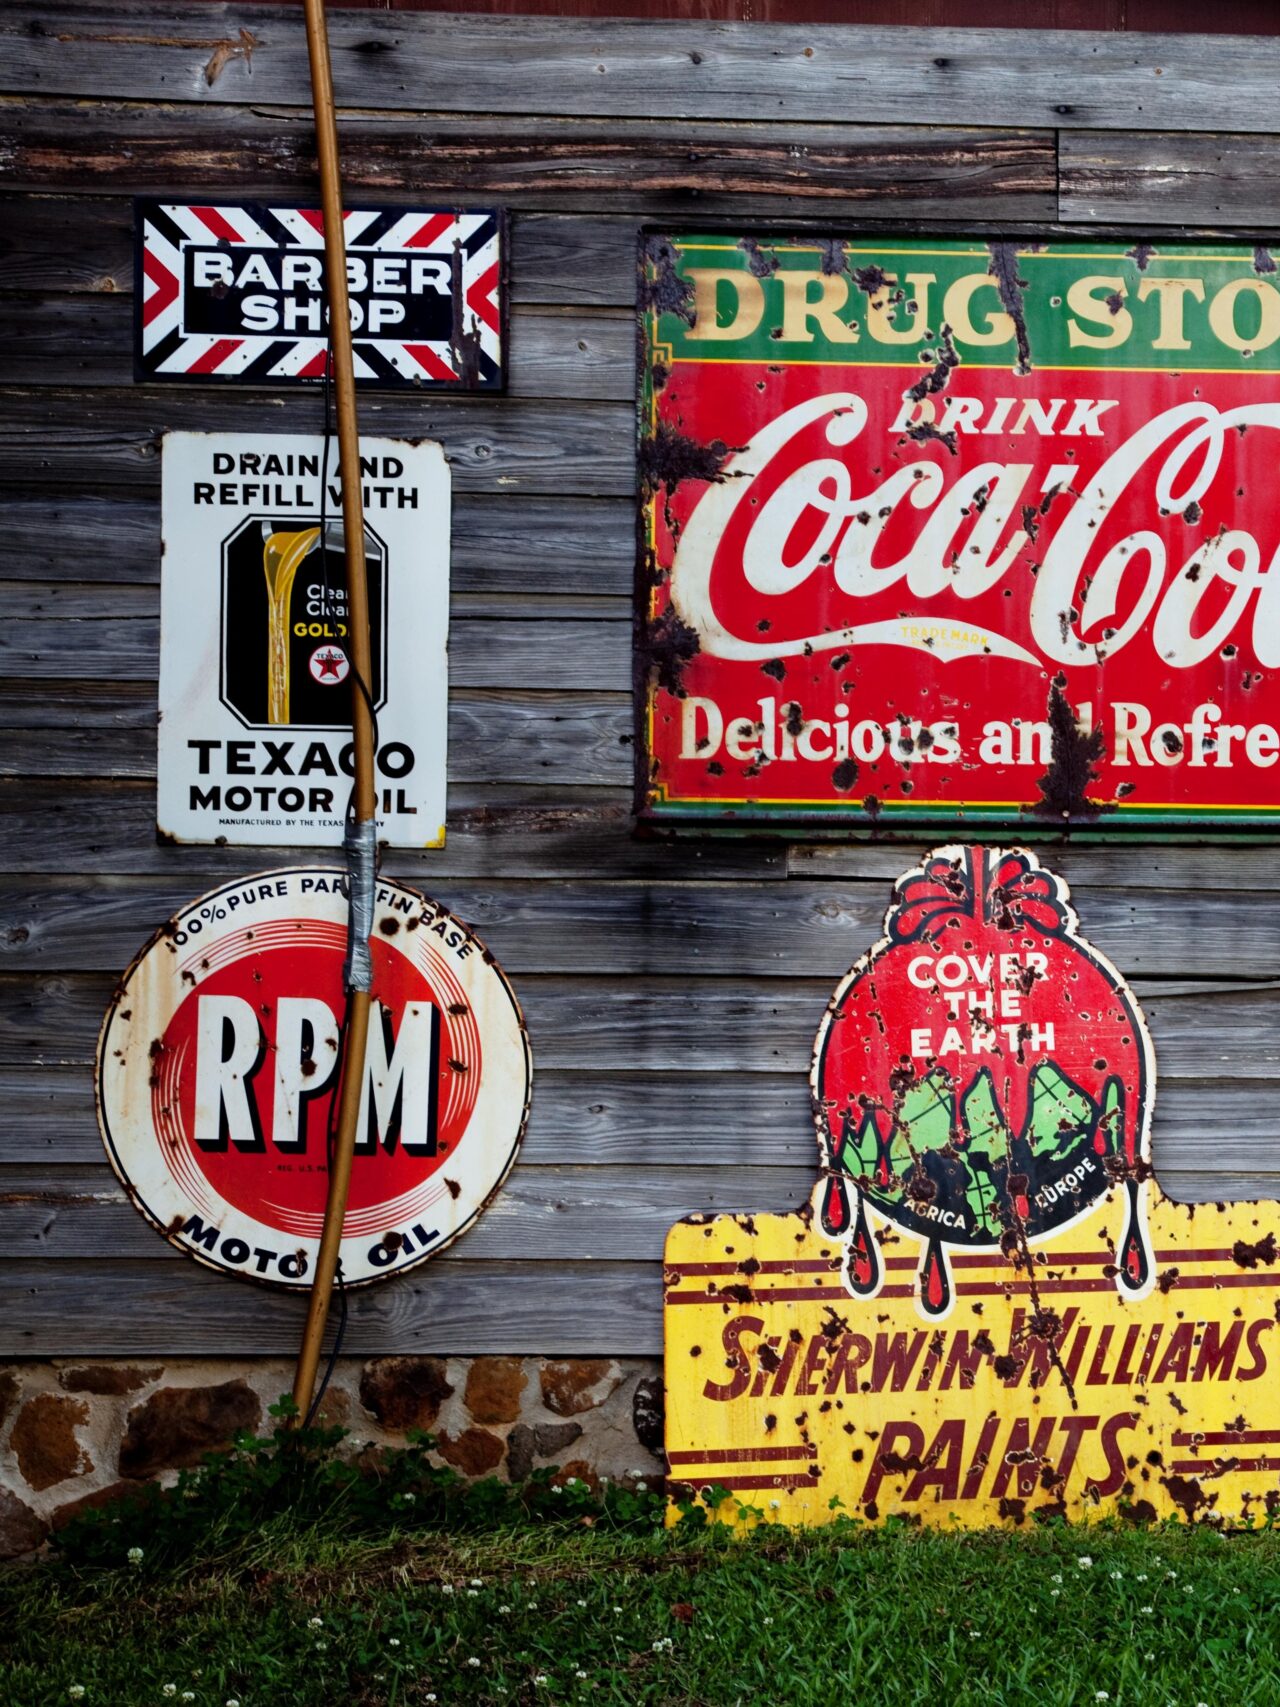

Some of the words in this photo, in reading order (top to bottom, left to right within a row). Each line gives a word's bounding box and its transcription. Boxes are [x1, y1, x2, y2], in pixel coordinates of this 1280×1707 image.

[194, 251, 453, 295] BARBER
[240, 295, 405, 333] SHOP
[683, 267, 1020, 348] DRUG
[889, 396, 1119, 437] DRINK
[213, 453, 320, 476] DRAIN
[334, 456, 404, 478] ND
[194, 483, 314, 507] REFILL
[306, 601, 349, 617] Clea
[307, 584, 348, 600] Clea
[678, 697, 959, 766] Delicious
[189, 785, 332, 813] MOTOR
[350, 787, 417, 814] IL
[300, 819, 314, 827] THE
[226, 881, 288, 911] PURE
[418, 910, 473, 960] BASE
[907, 952, 1049, 989] COVER
[944, 991, 1021, 1019] THE
[911, 1023, 1055, 1058] EARTH
[193, 995, 438, 1152] RPM
[1036, 1157, 1096, 1208] EUROPE
[367, 1223, 441, 1268] OIL
[861, 1411, 1138, 1504] PAINTS
